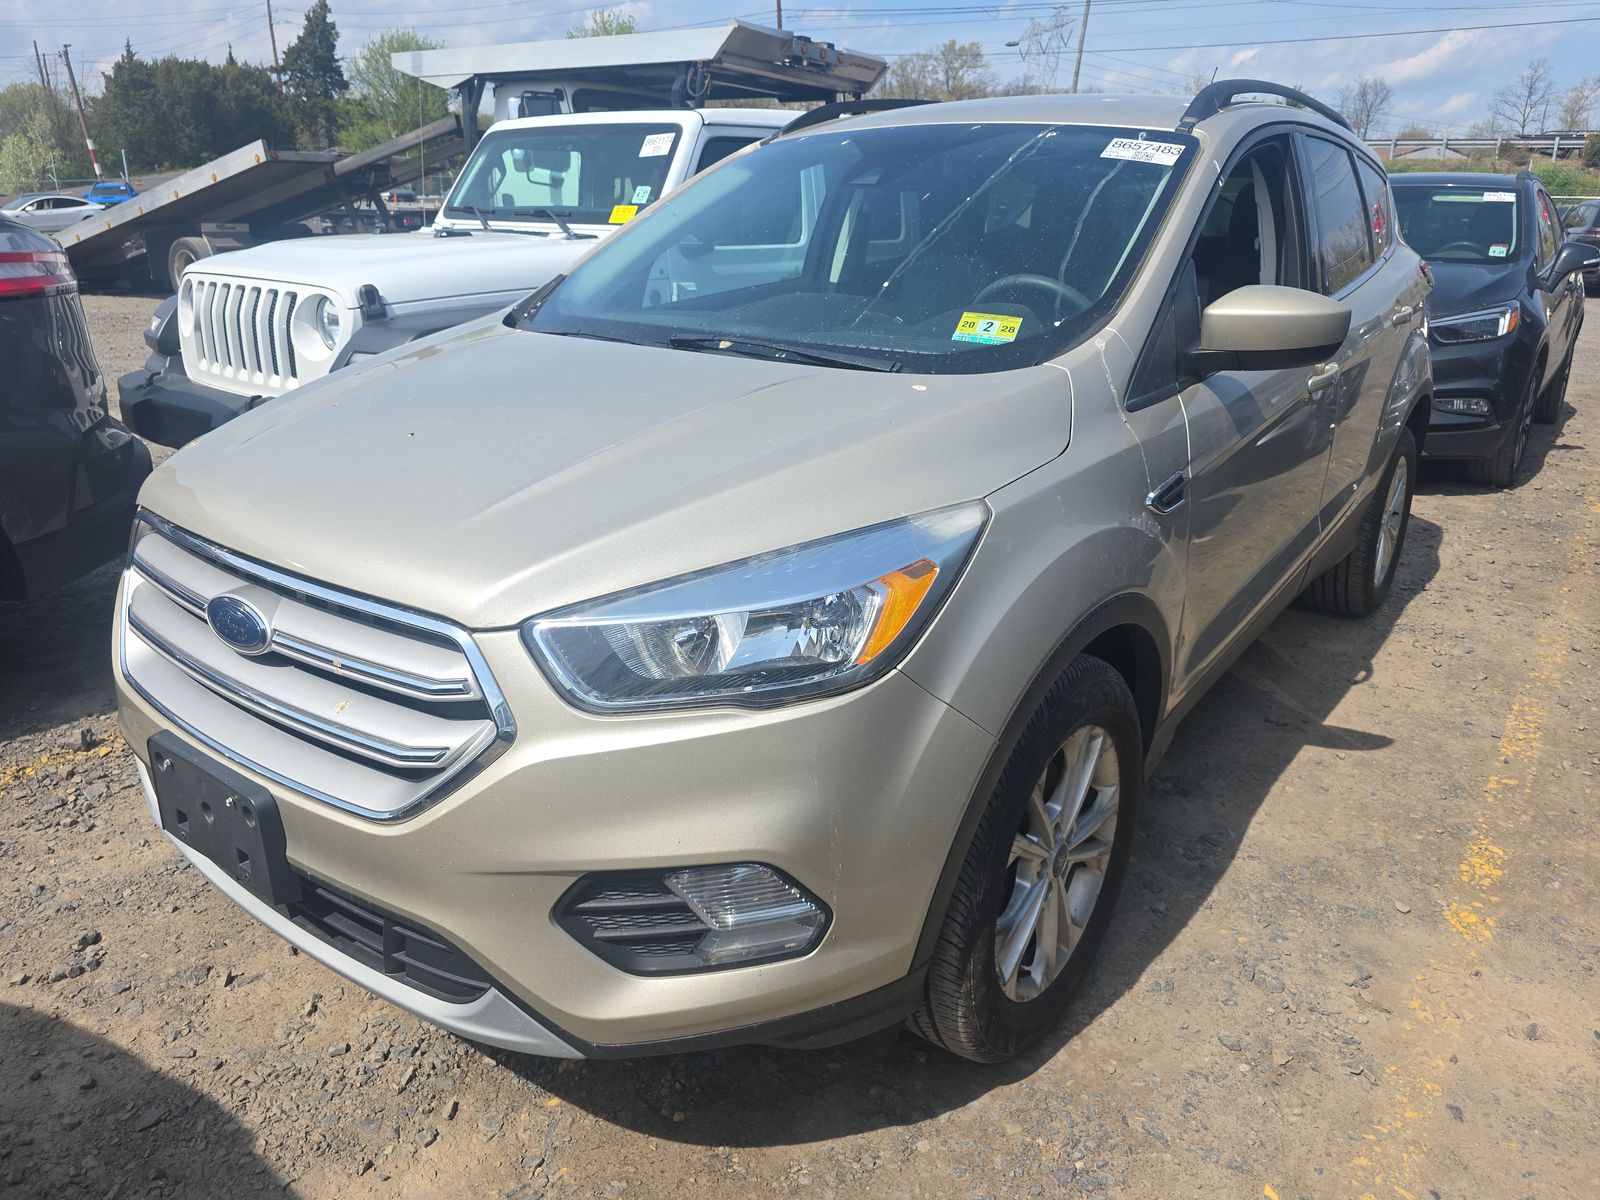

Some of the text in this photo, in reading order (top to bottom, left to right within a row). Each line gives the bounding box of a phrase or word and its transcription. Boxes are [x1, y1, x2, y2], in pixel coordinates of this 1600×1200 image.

[1111, 140, 1183, 156] 8657483
[961, 320, 1016, 334] 20 2 28
